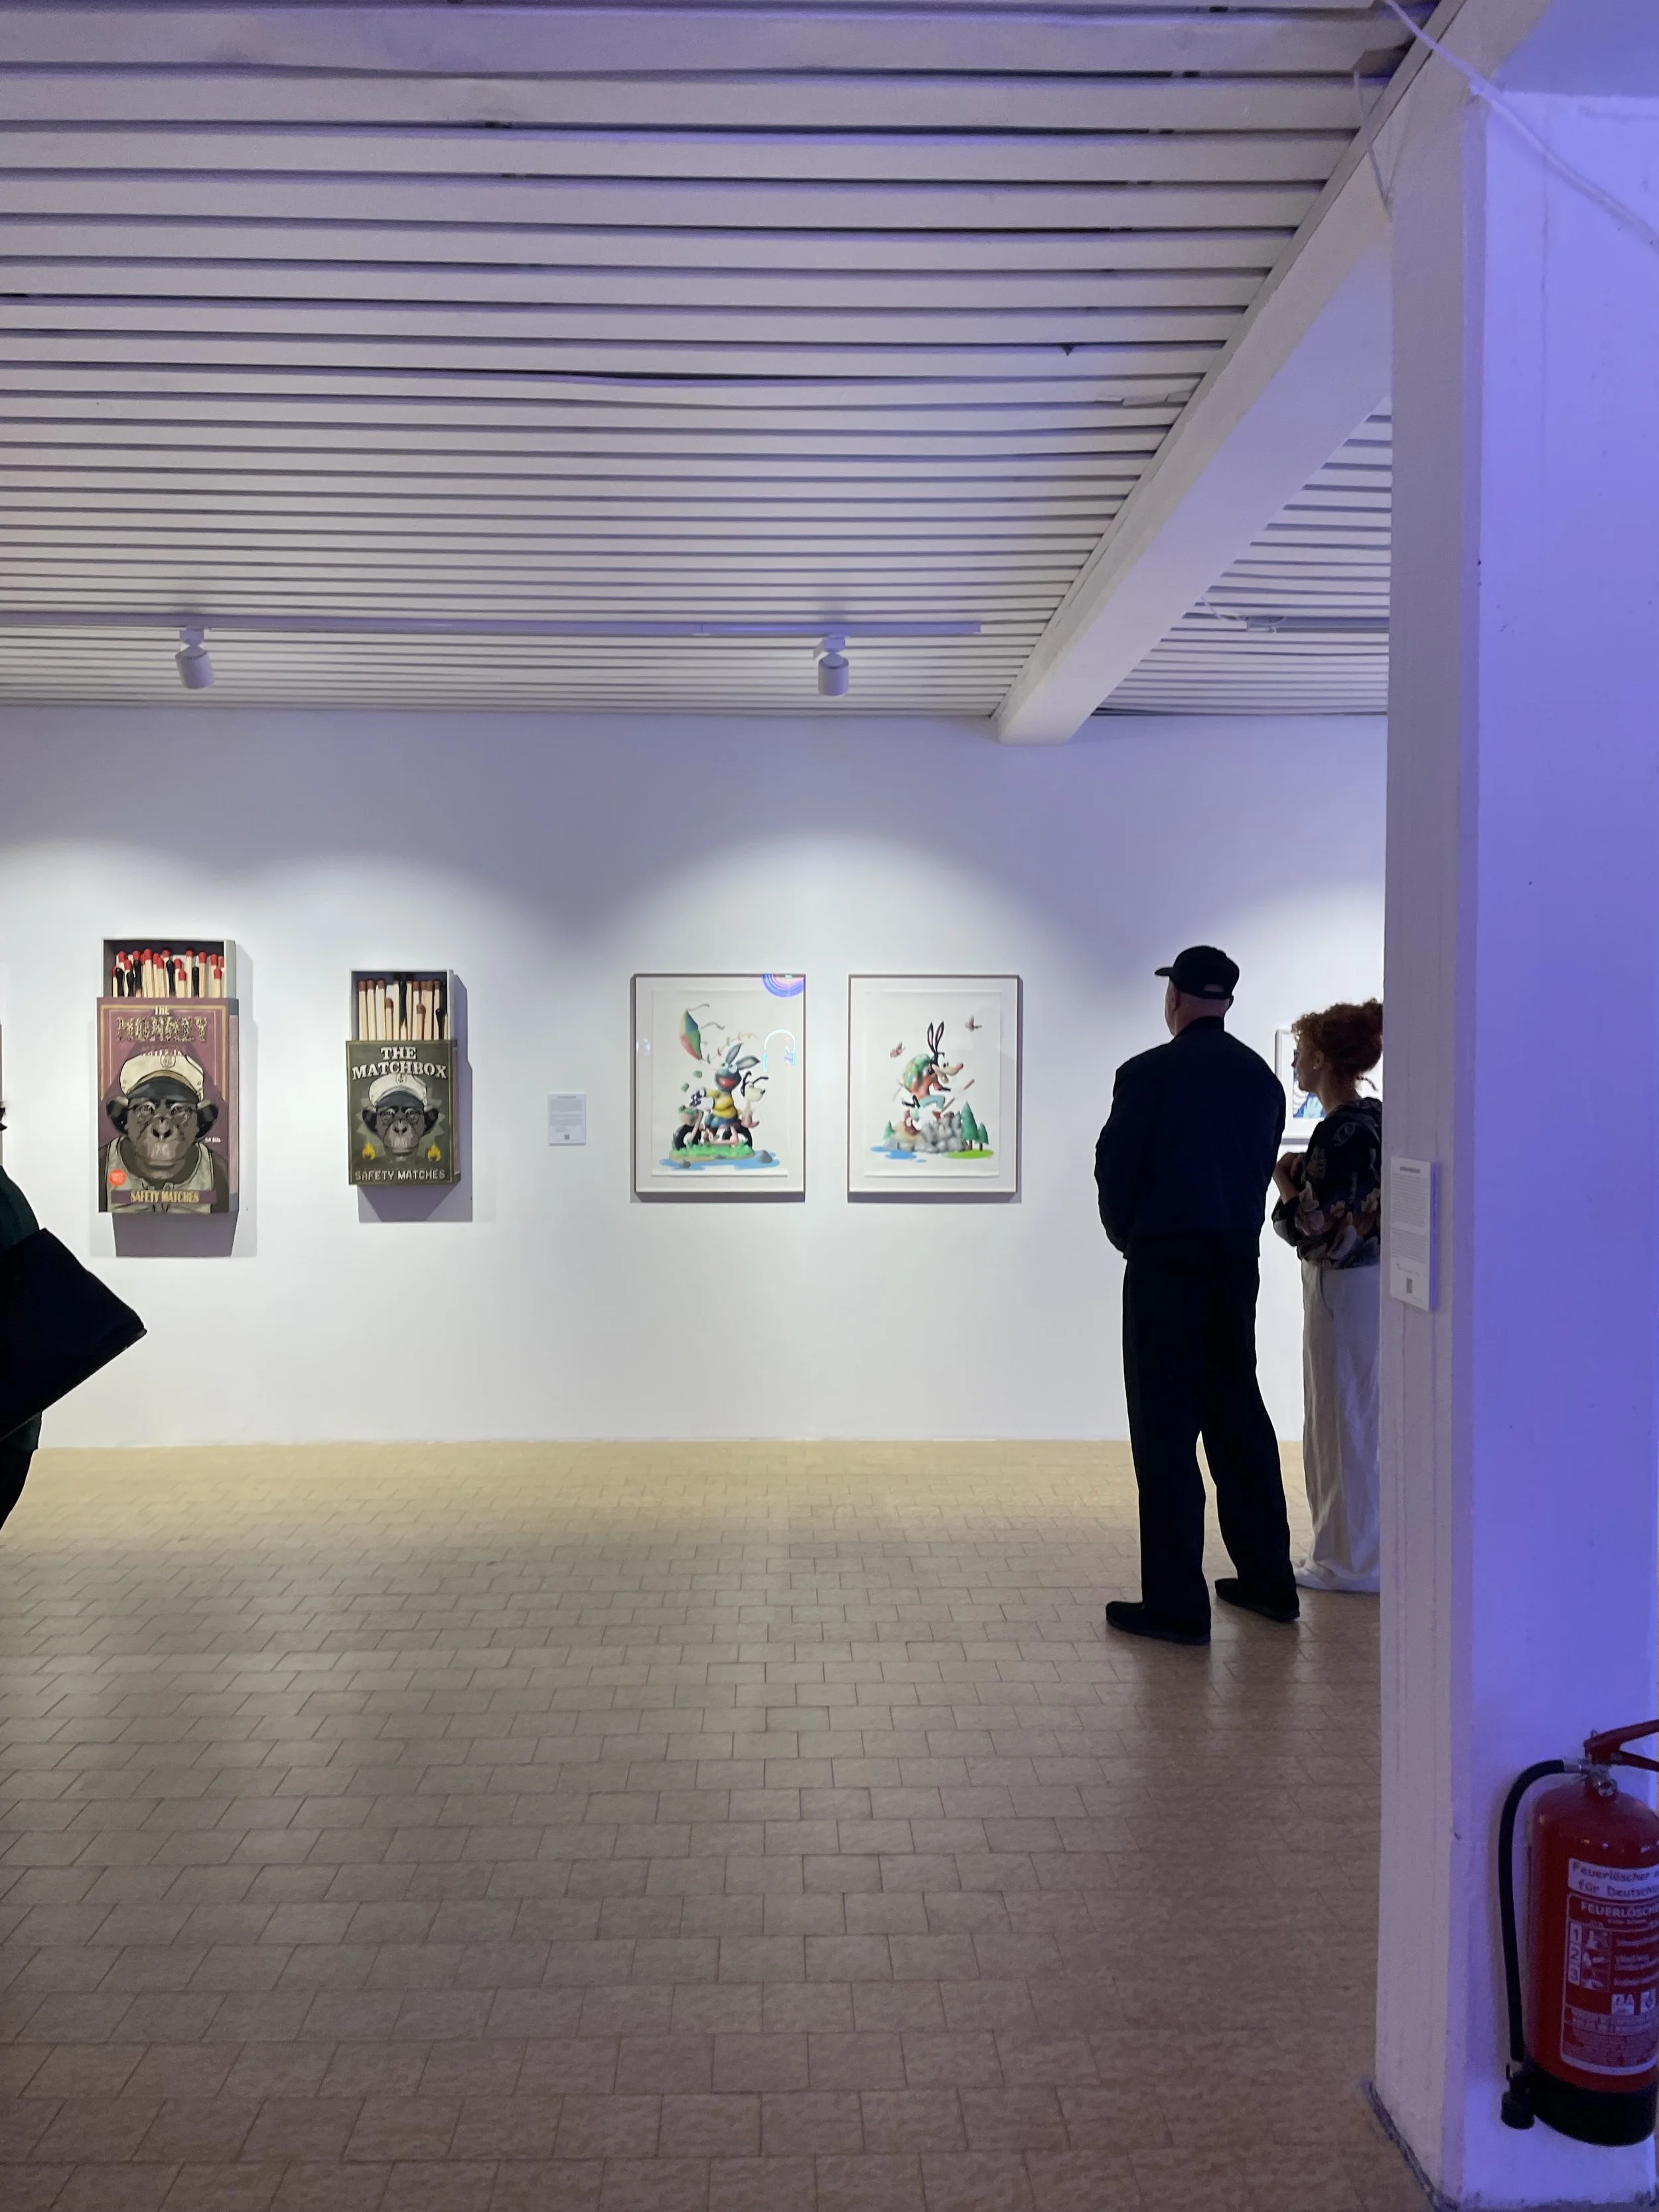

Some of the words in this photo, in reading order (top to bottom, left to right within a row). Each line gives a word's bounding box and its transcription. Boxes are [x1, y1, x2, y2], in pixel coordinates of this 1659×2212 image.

[380, 1046, 417, 1061] THE
[351, 1061, 447, 1080] MATCHBOX
[354, 1169, 395, 1181] SAFETY
[397, 1169, 446, 1181] MATCHES
[130, 1190, 160, 1203] SAFETY
[161, 1190, 199, 1203] MATCHES
